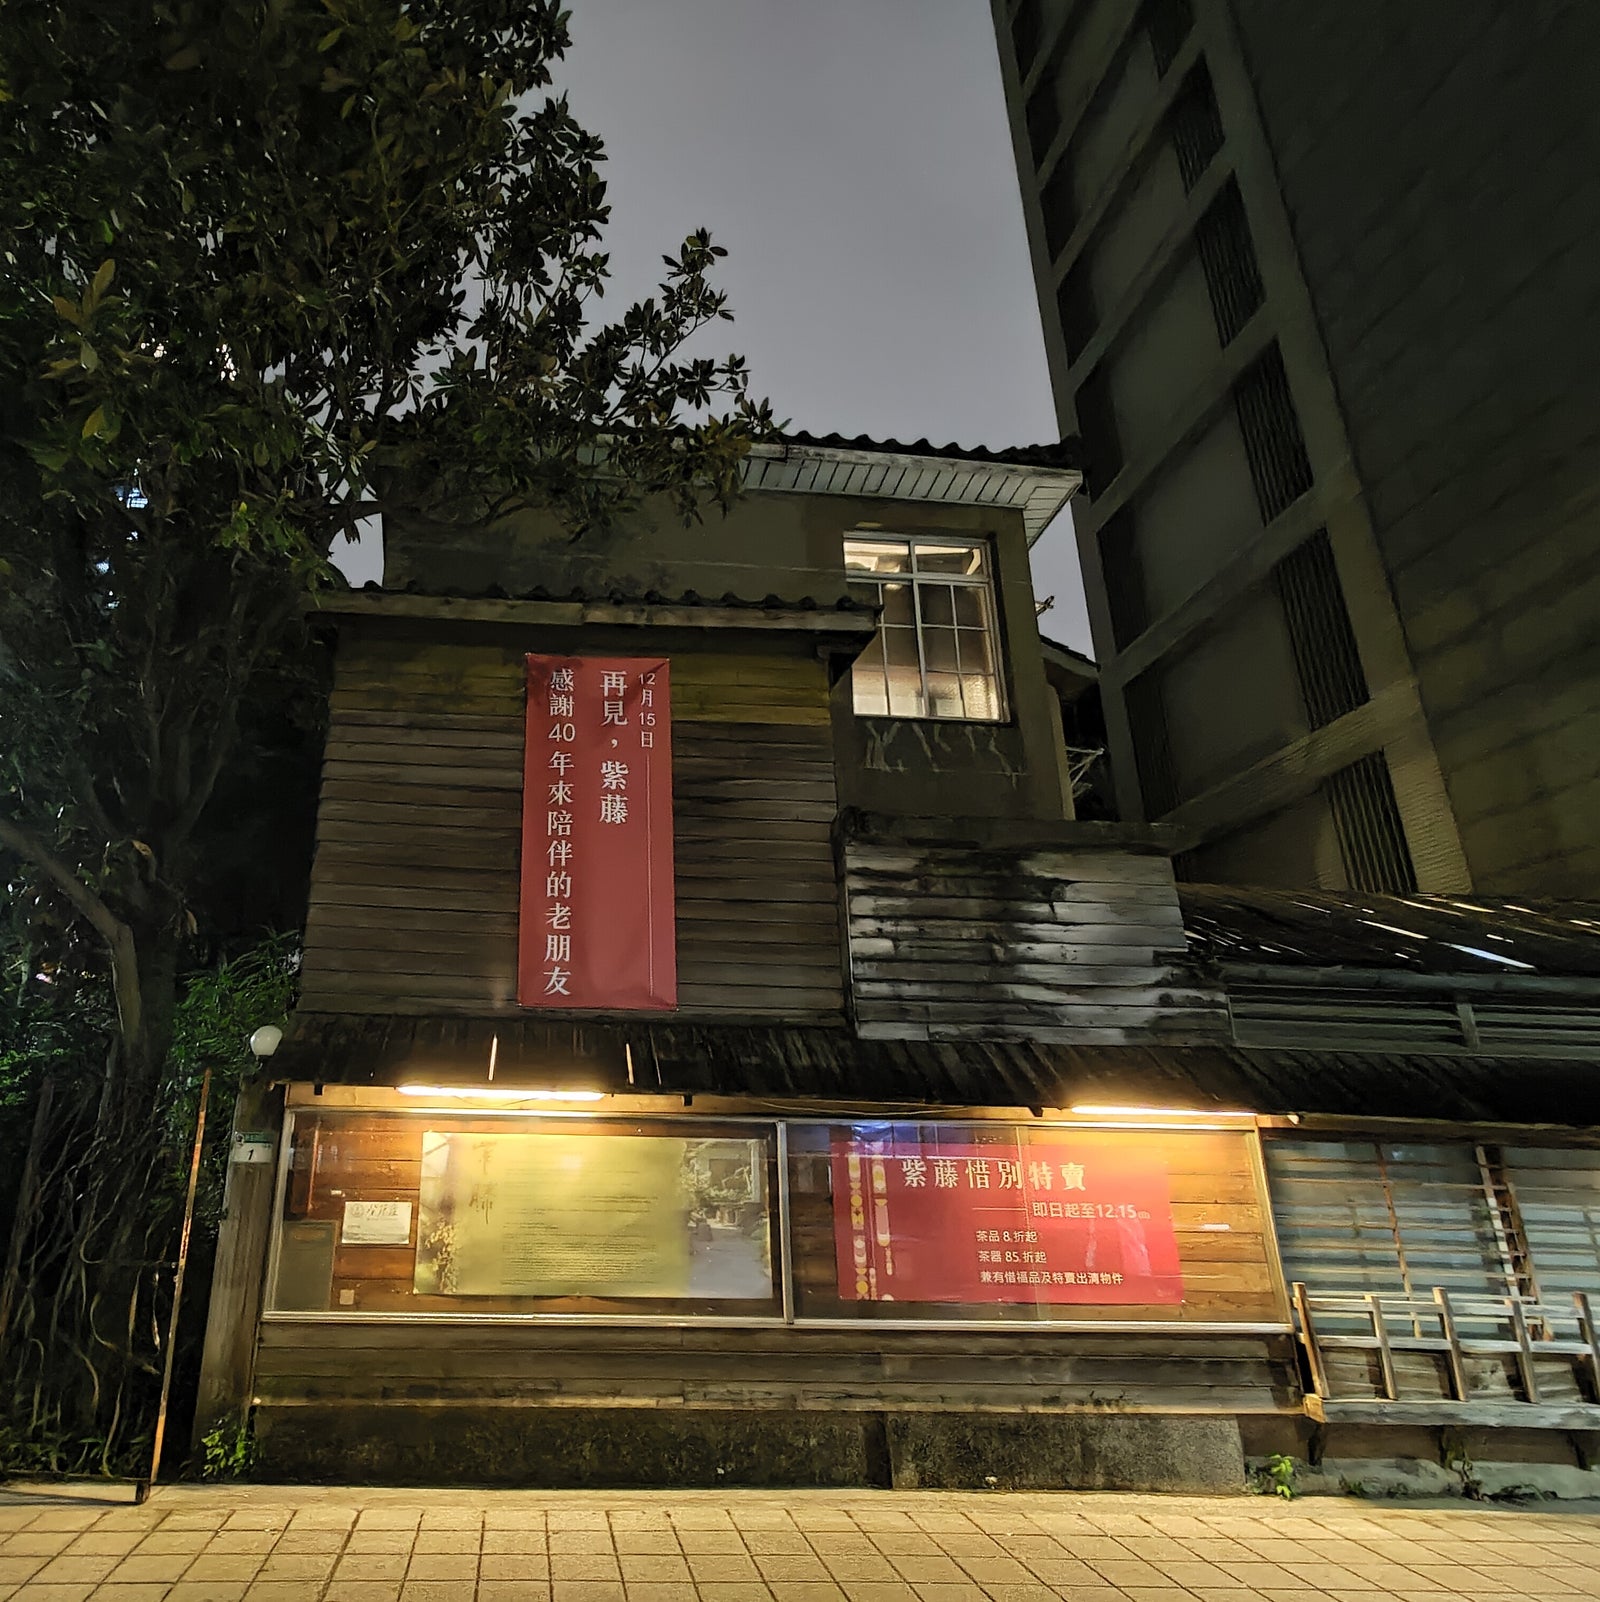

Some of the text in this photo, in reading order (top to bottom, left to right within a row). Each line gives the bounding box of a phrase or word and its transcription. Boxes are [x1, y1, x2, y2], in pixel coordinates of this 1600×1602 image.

[639, 673, 656, 749] 12月15日
[543, 668, 576, 996] 感謝40年來陪伴的老朋友
[901, 1158, 1087, 1191] 紫藤惜別特賣
[976, 1230, 1000, 1243] 茶品
[1013, 1230, 1038, 1243] 折起
[1005, 1251, 1019, 1263] 85
[1022, 1251, 1047, 1264] 折起
